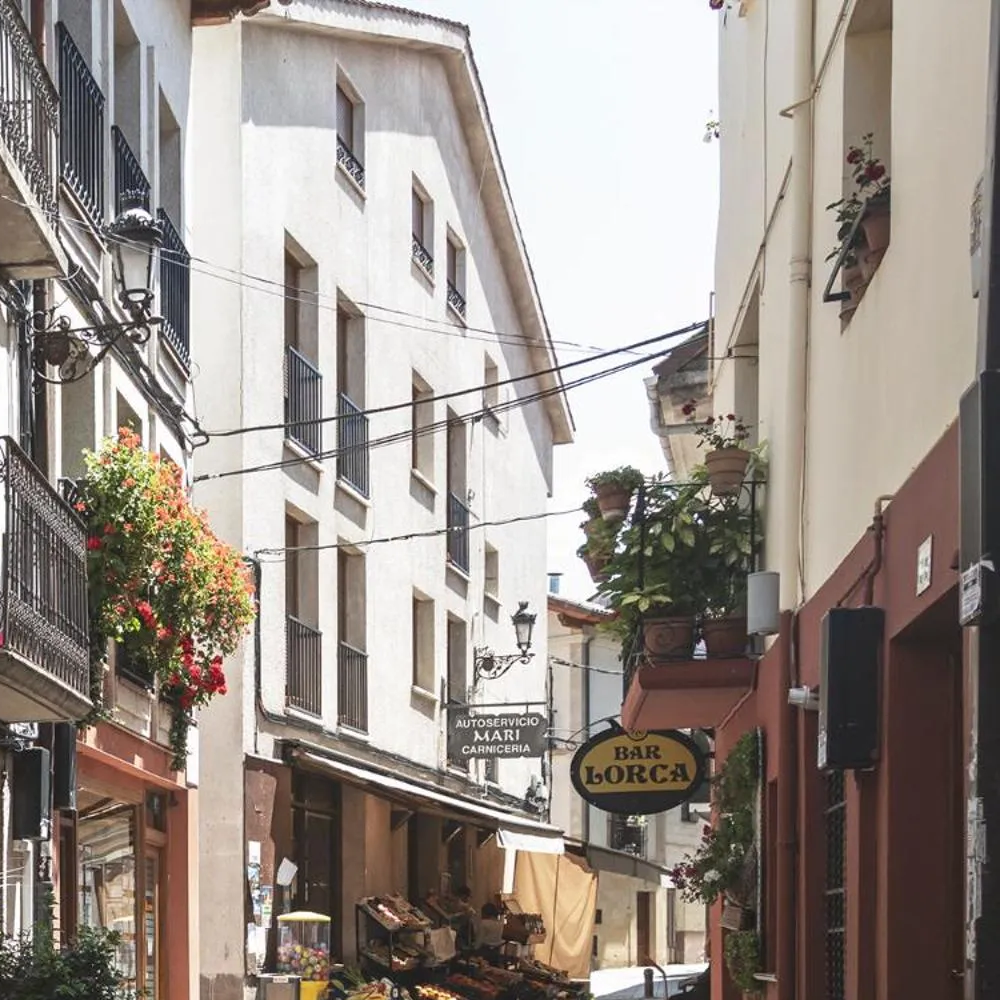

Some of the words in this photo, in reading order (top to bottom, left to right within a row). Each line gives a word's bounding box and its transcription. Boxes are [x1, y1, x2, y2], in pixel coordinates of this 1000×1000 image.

[455, 716, 539, 729] AUTOSERVICIO
[473, 729, 520, 742] MARI
[462, 744, 531, 755] CARNICERIA
[614, 744, 662, 761] BAR
[585, 763, 691, 785] LORCA
